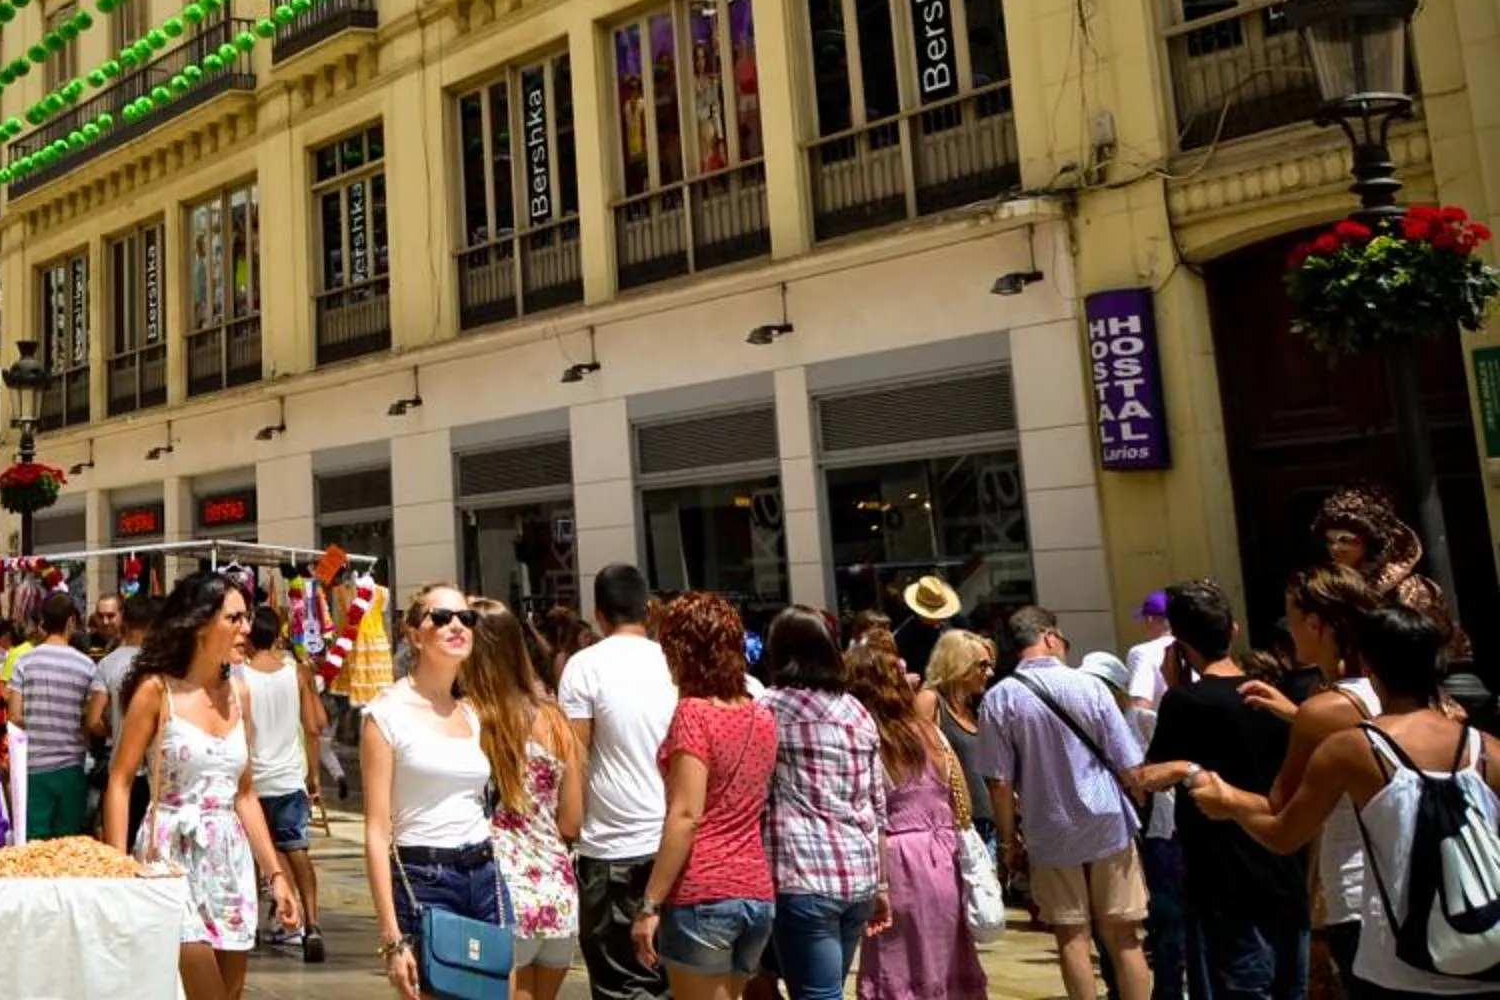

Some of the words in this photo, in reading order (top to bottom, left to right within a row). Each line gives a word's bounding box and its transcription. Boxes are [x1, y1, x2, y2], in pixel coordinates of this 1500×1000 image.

[527, 89, 549, 217] Bershka
[146, 244, 158, 340] Bershka
[1089, 318, 1116, 444] HOSTAL
[1107, 314, 1153, 442] HOSTAL
